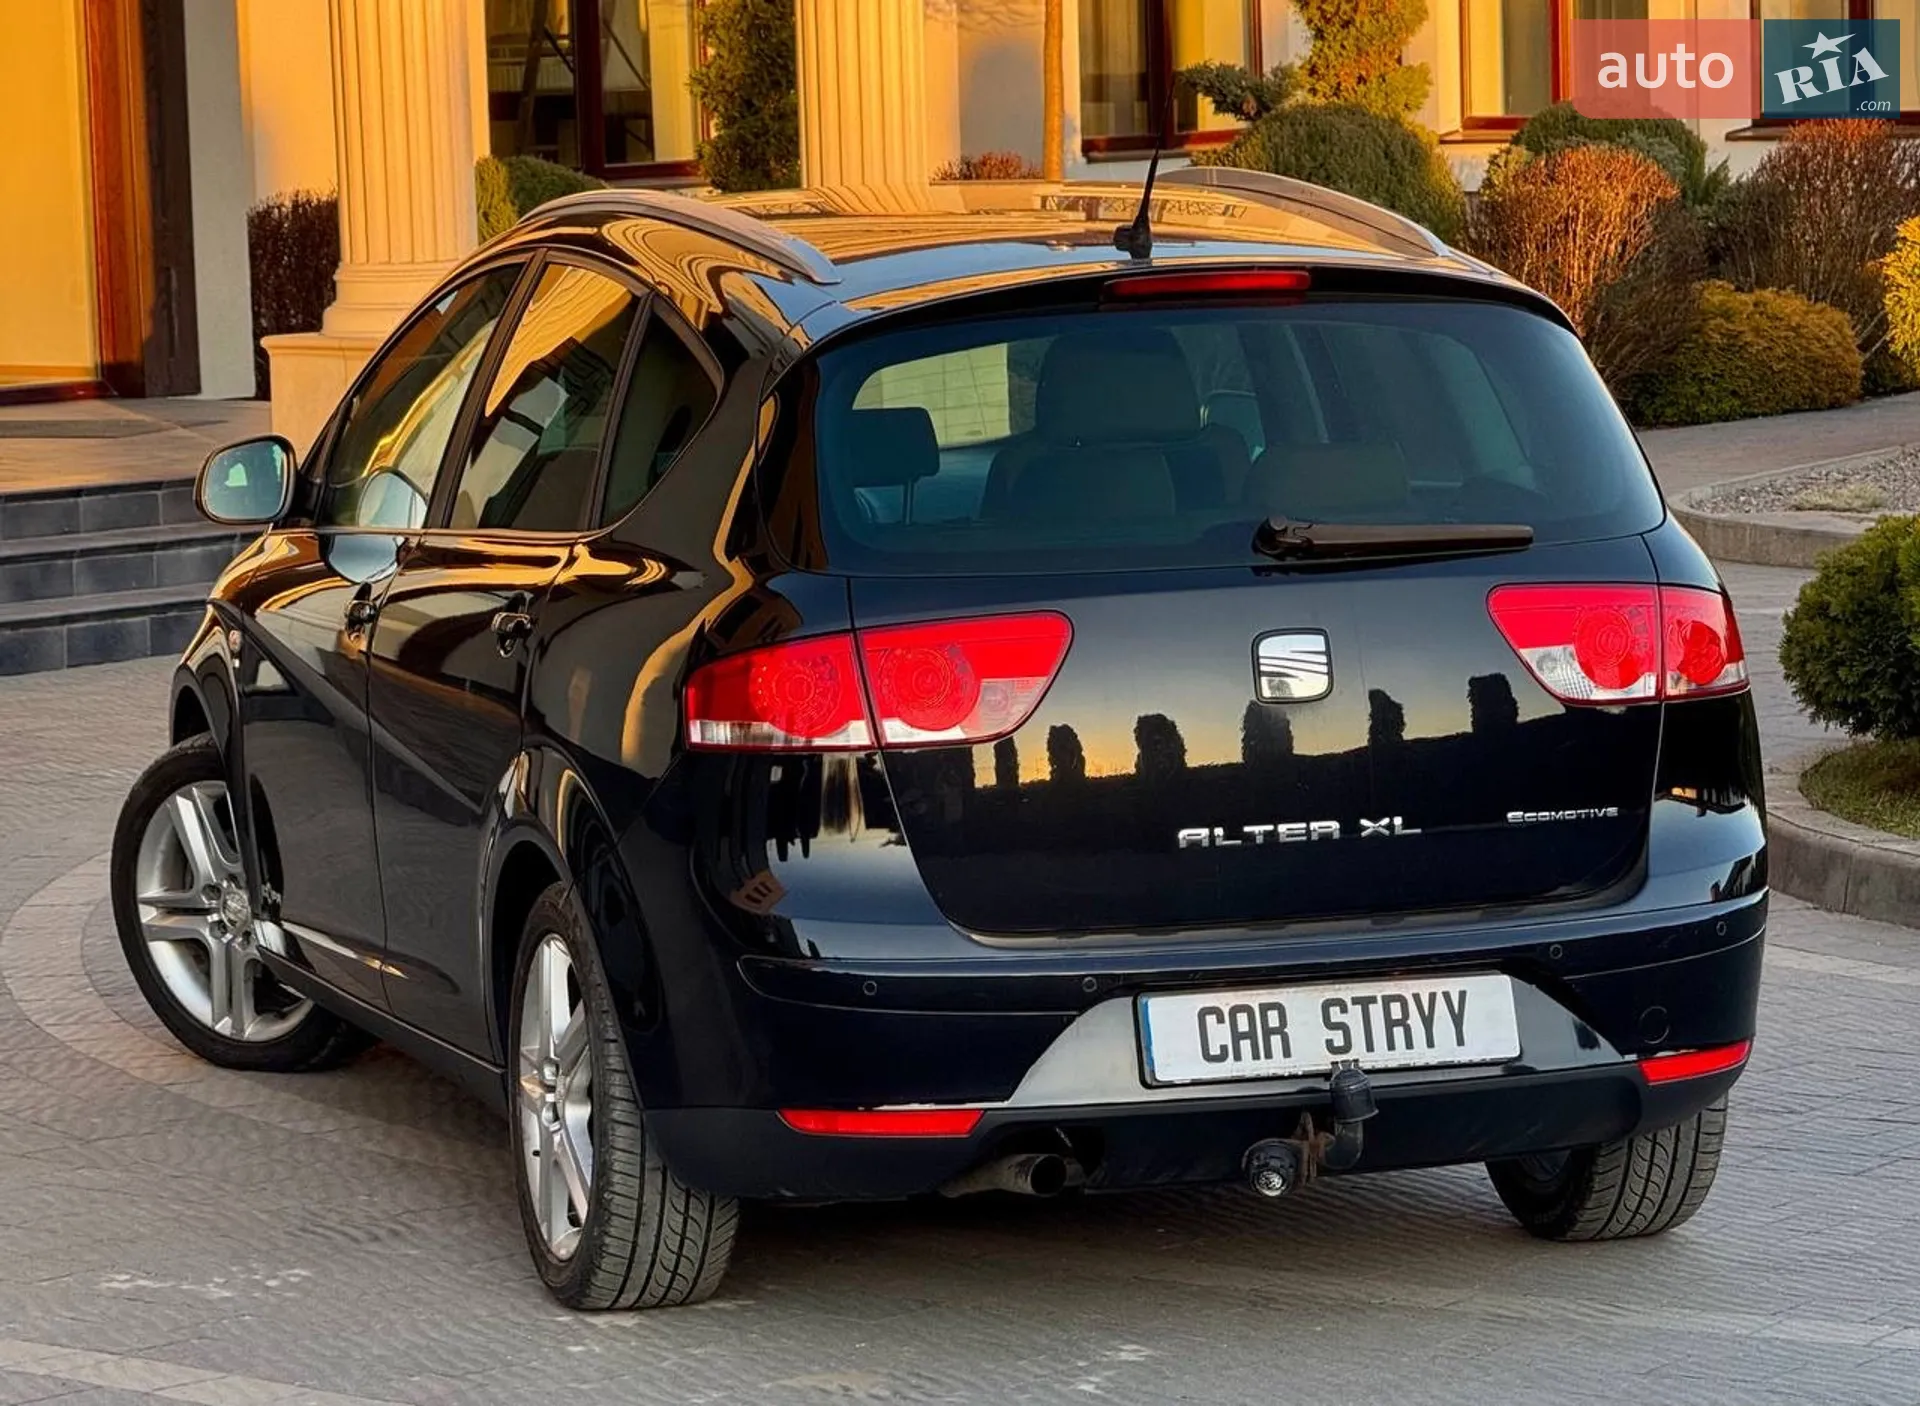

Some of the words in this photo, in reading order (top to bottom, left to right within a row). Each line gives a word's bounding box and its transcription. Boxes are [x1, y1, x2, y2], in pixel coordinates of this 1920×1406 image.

[1359, 816, 1422, 837] XL
[1197, 1001, 1292, 1063] CAR
[1321, 990, 1468, 1055] STRYY
